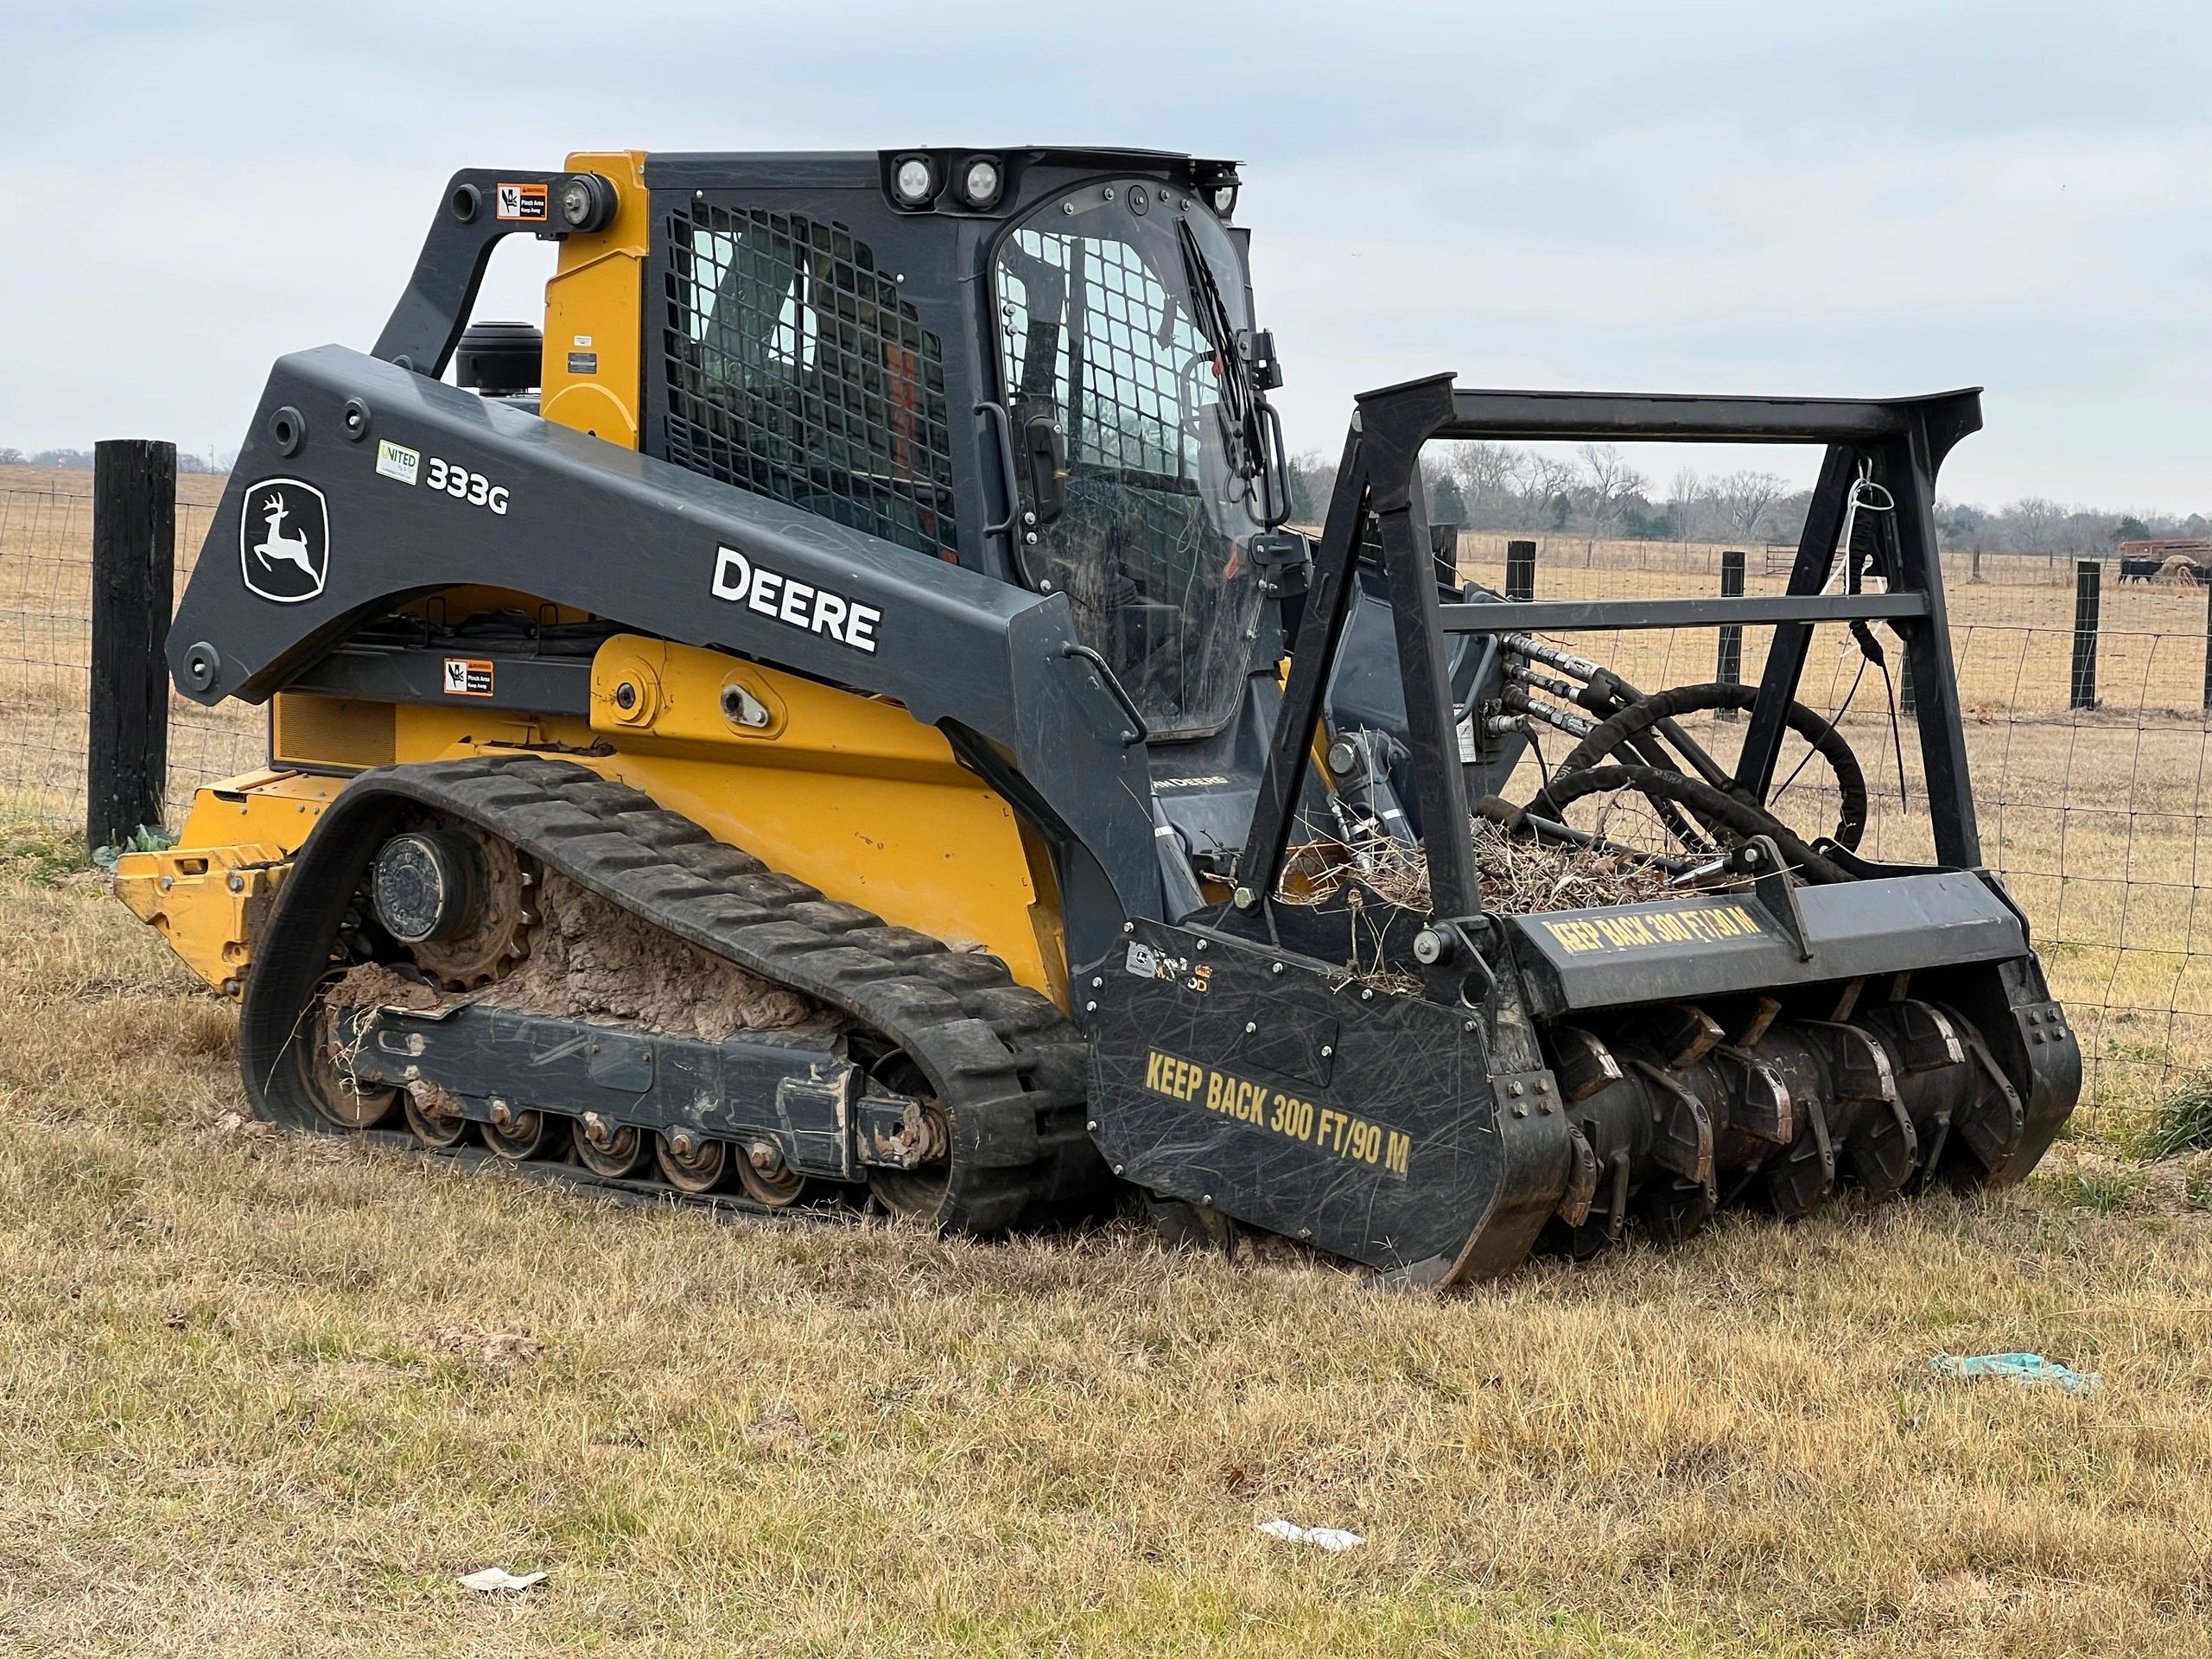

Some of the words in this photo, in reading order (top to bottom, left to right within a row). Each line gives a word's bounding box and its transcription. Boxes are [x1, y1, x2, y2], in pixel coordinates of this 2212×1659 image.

[381, 444, 416, 467] UNITED
[426, 457, 510, 515] 333G
[711, 545, 881, 653] DEERE
[1169, 776, 1229, 787] DEERE
[1544, 920, 1605, 954] KEEP
[1593, 916, 1661, 947] BACK
[1644, 912, 1694, 941] 300
[1726, 906, 1762, 934] M
[1146, 1052, 1203, 1102] KEEP
[1206, 1071, 1268, 1127] BACK
[1270, 1094, 1313, 1141] 300
[1317, 1108, 1382, 1165] FT/90
[1385, 1130, 1410, 1173] M
